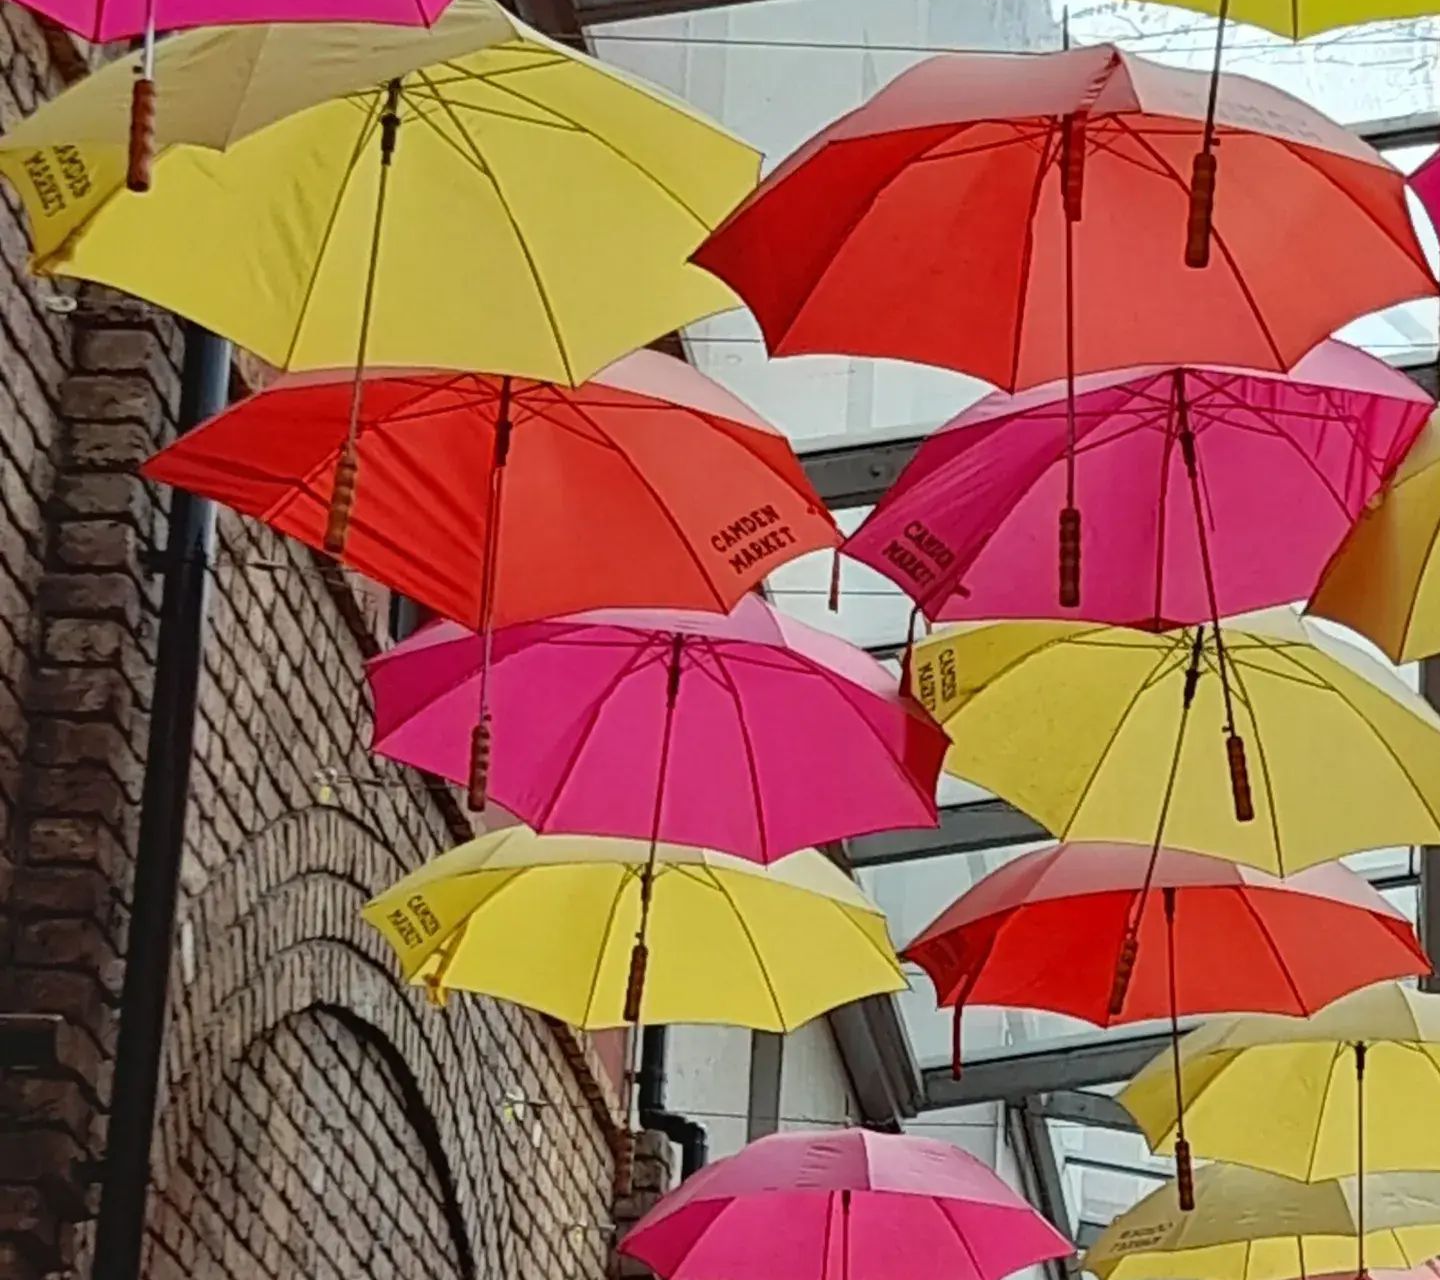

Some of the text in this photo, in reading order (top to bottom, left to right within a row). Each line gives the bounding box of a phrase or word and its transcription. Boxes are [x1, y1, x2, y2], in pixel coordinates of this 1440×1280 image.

[22, 150, 67, 218] MARKET
[52, 144, 92, 199] AMDEN
[710, 504, 782, 553] CAMDEN
[728, 526, 797, 575] MARKET
[882, 539, 937, 589] MARKET
